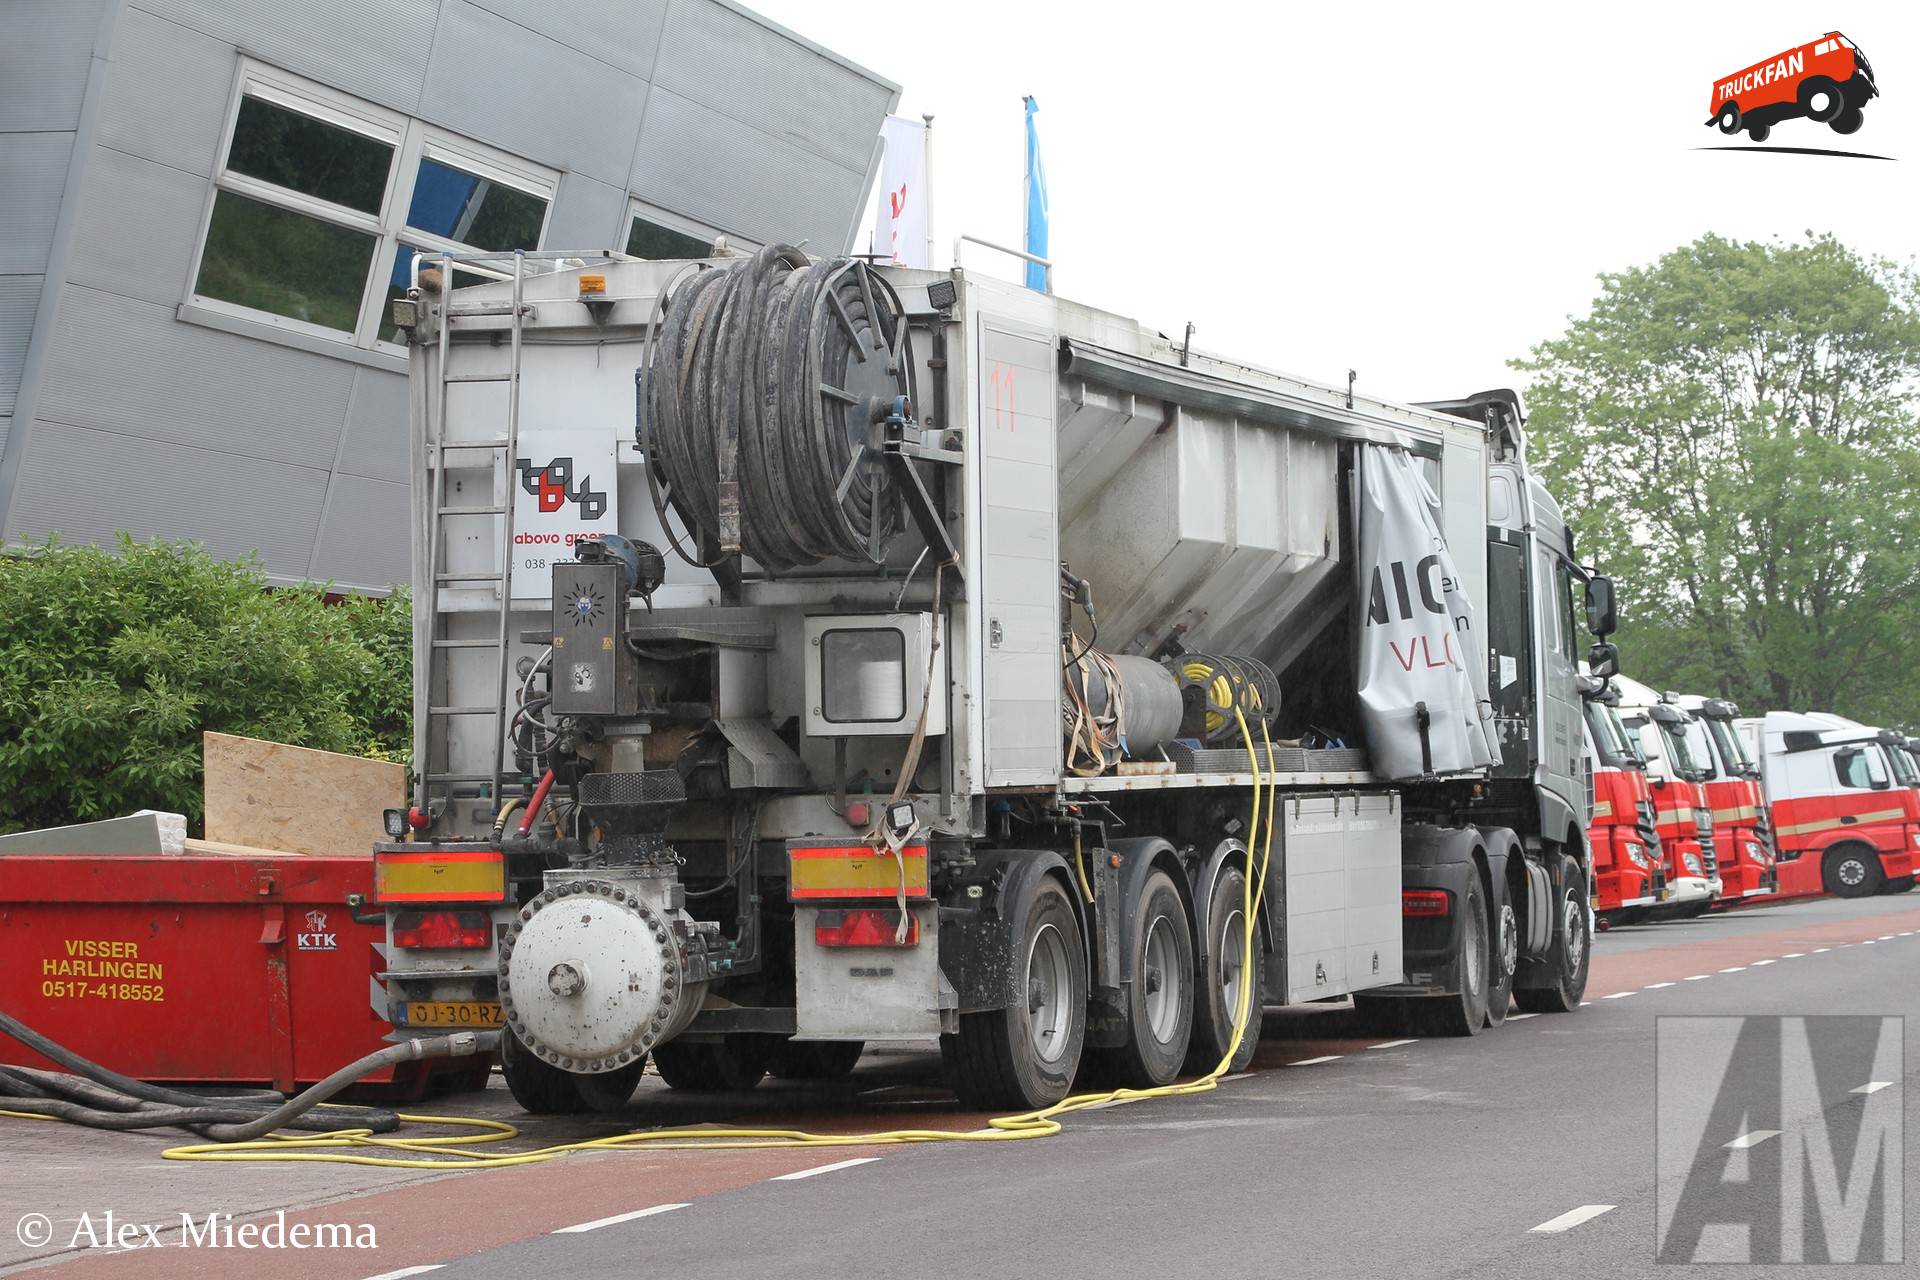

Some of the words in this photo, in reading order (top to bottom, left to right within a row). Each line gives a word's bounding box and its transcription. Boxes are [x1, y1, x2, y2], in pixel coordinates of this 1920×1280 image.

[514, 532, 560, 545] abovo
[525, 559, 546, 569] 038
[297, 933, 337, 946] KTK
[65, 940, 138, 958] VISSER
[43, 959, 163, 980] HARLINGEN
[42, 981, 164, 1002] 0517-418552
